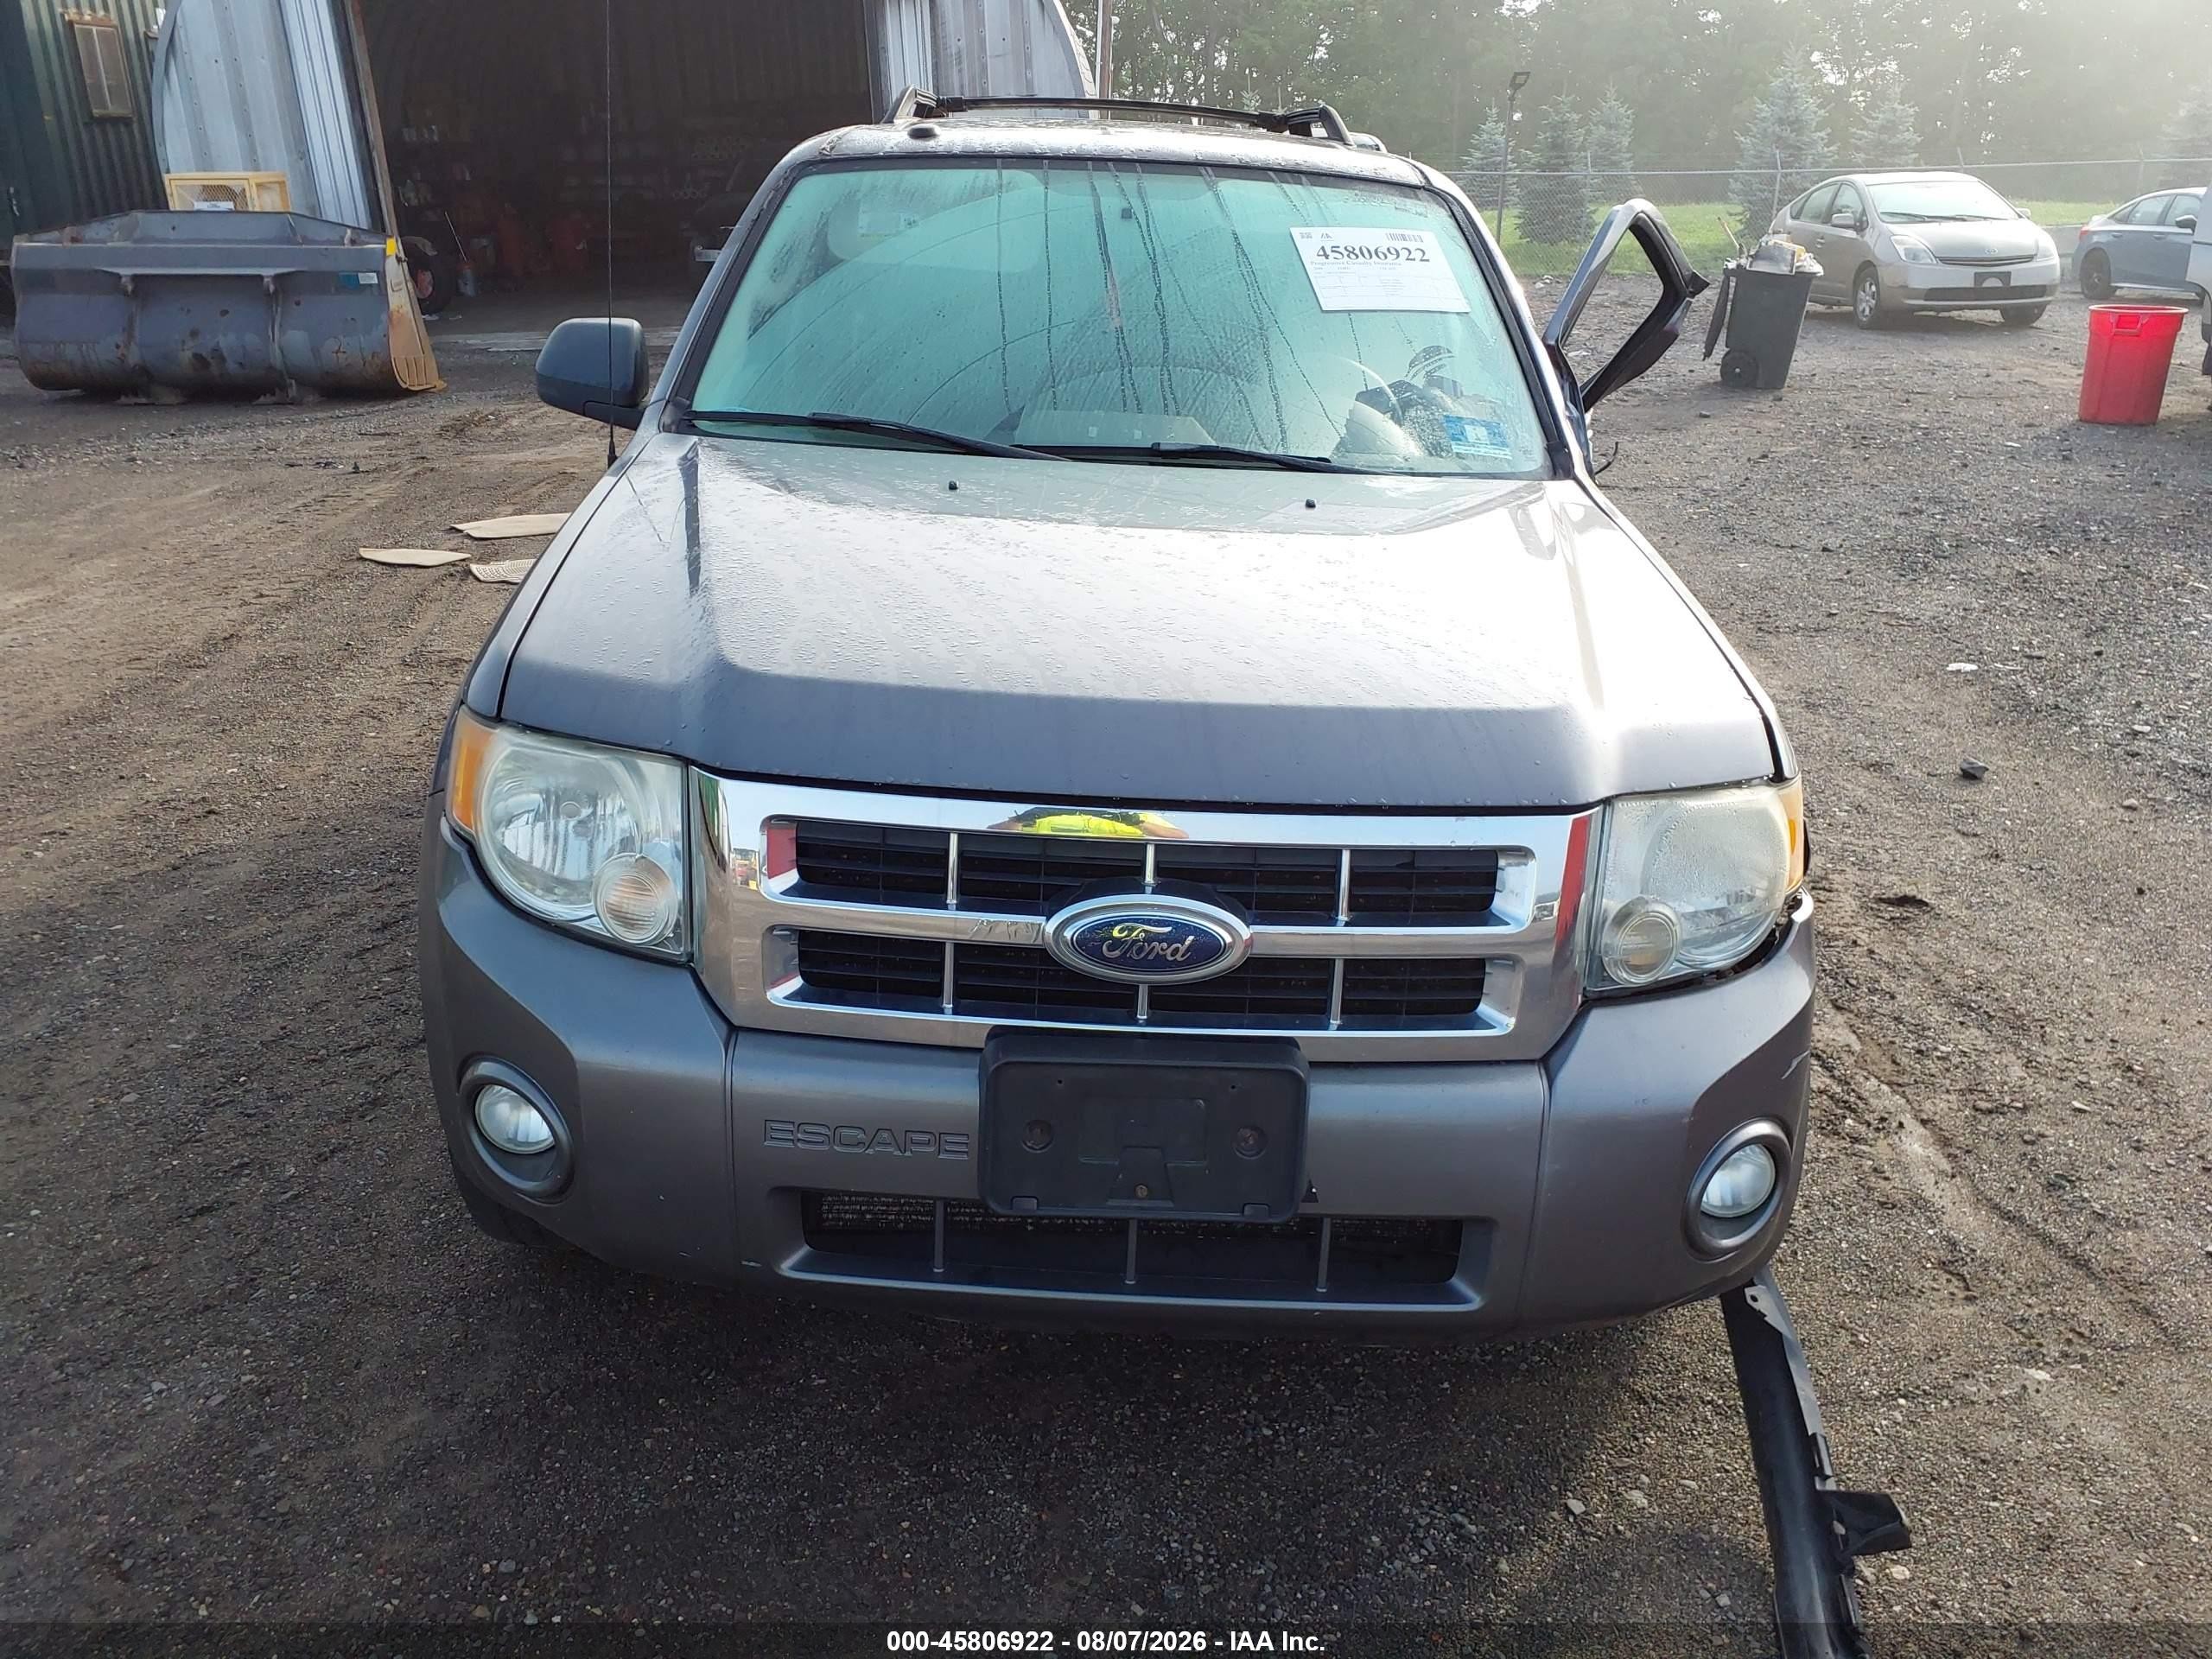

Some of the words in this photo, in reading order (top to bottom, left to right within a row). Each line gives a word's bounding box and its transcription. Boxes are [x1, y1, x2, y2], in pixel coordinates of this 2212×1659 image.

[1316, 245, 1430, 263] 45806922
[1102, 922, 1195, 962] Ford
[764, 1119, 969, 1160] ESCAPE
